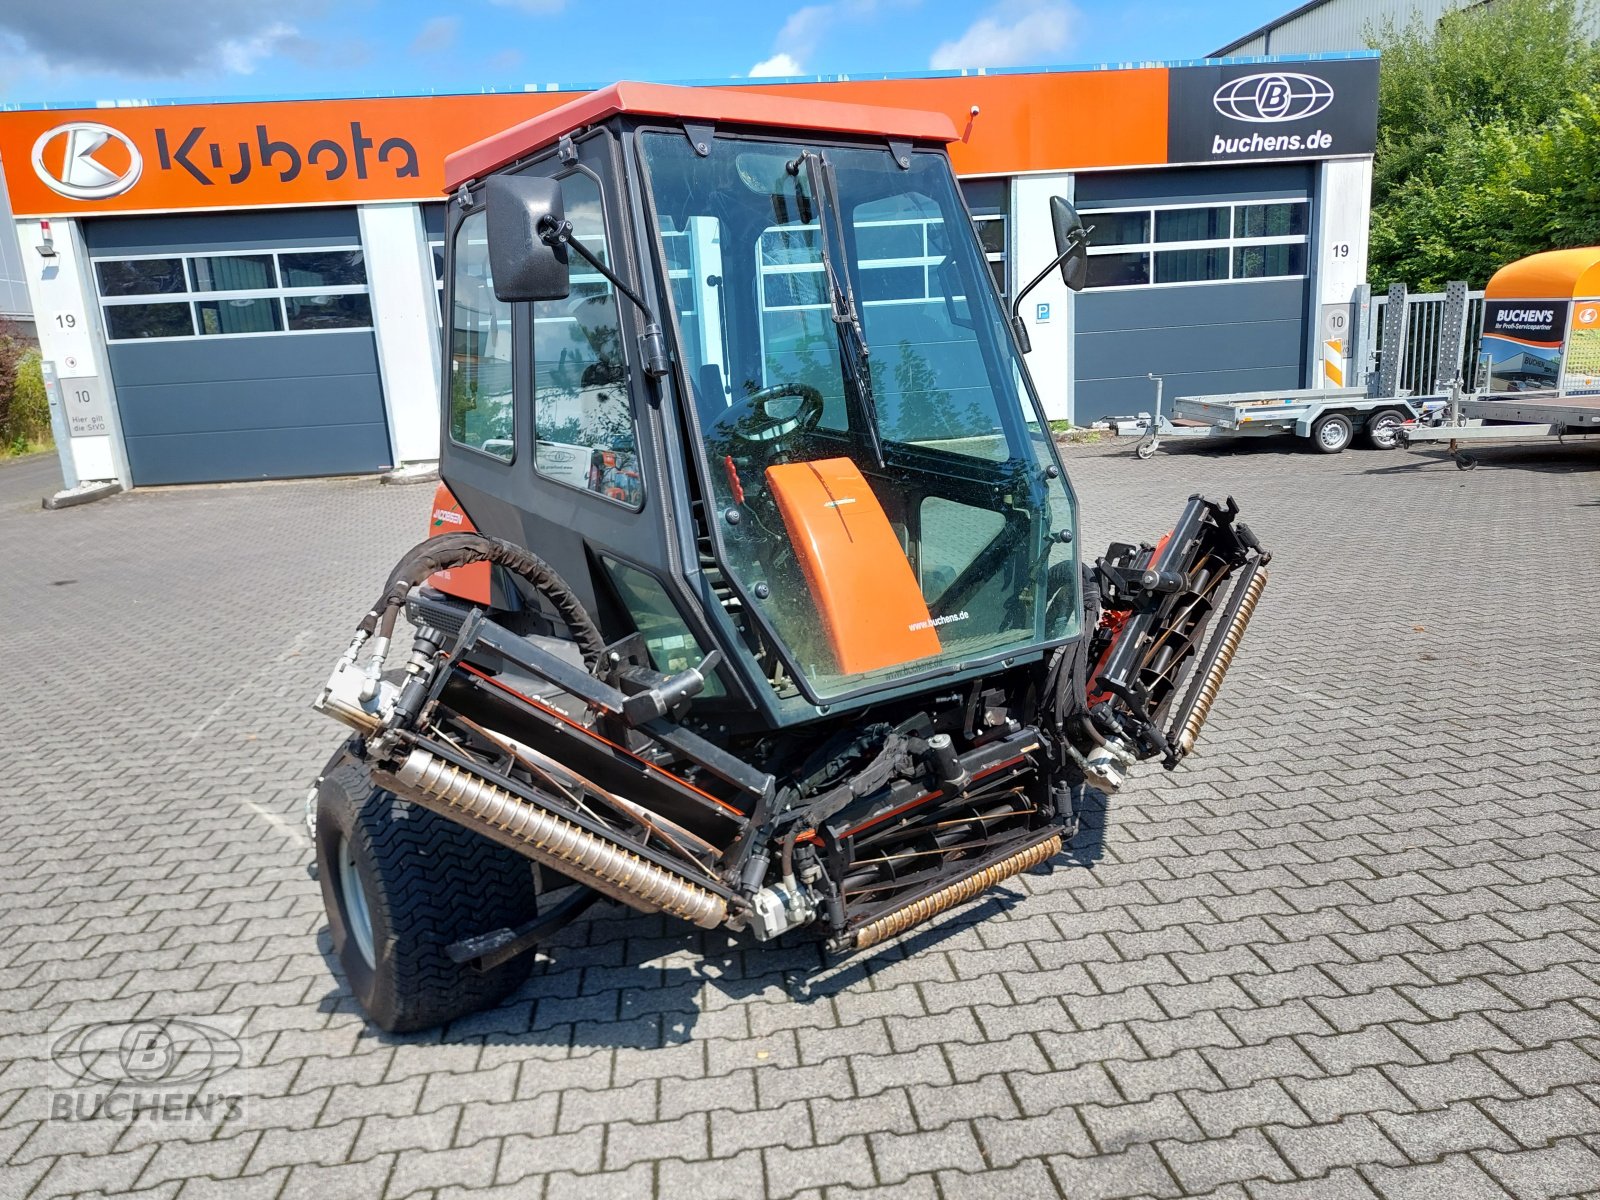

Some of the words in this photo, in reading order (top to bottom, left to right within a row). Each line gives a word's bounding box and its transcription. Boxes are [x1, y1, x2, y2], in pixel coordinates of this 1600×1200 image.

[1211, 129, 1333, 154] buchens.de
[154, 122, 419, 185] Kubota
[1332, 244, 1350, 258] 19
[1038, 305, 1049, 319] P
[1496, 309, 1554, 322] BUCHEN'S
[55, 314, 76, 329] 19
[1331, 316, 1344, 328] 10
[75, 390, 91, 403] 10
[72, 416, 88, 424] Hier
[74, 424, 86, 432] die
[908, 610, 970, 632] www.buchens.de
